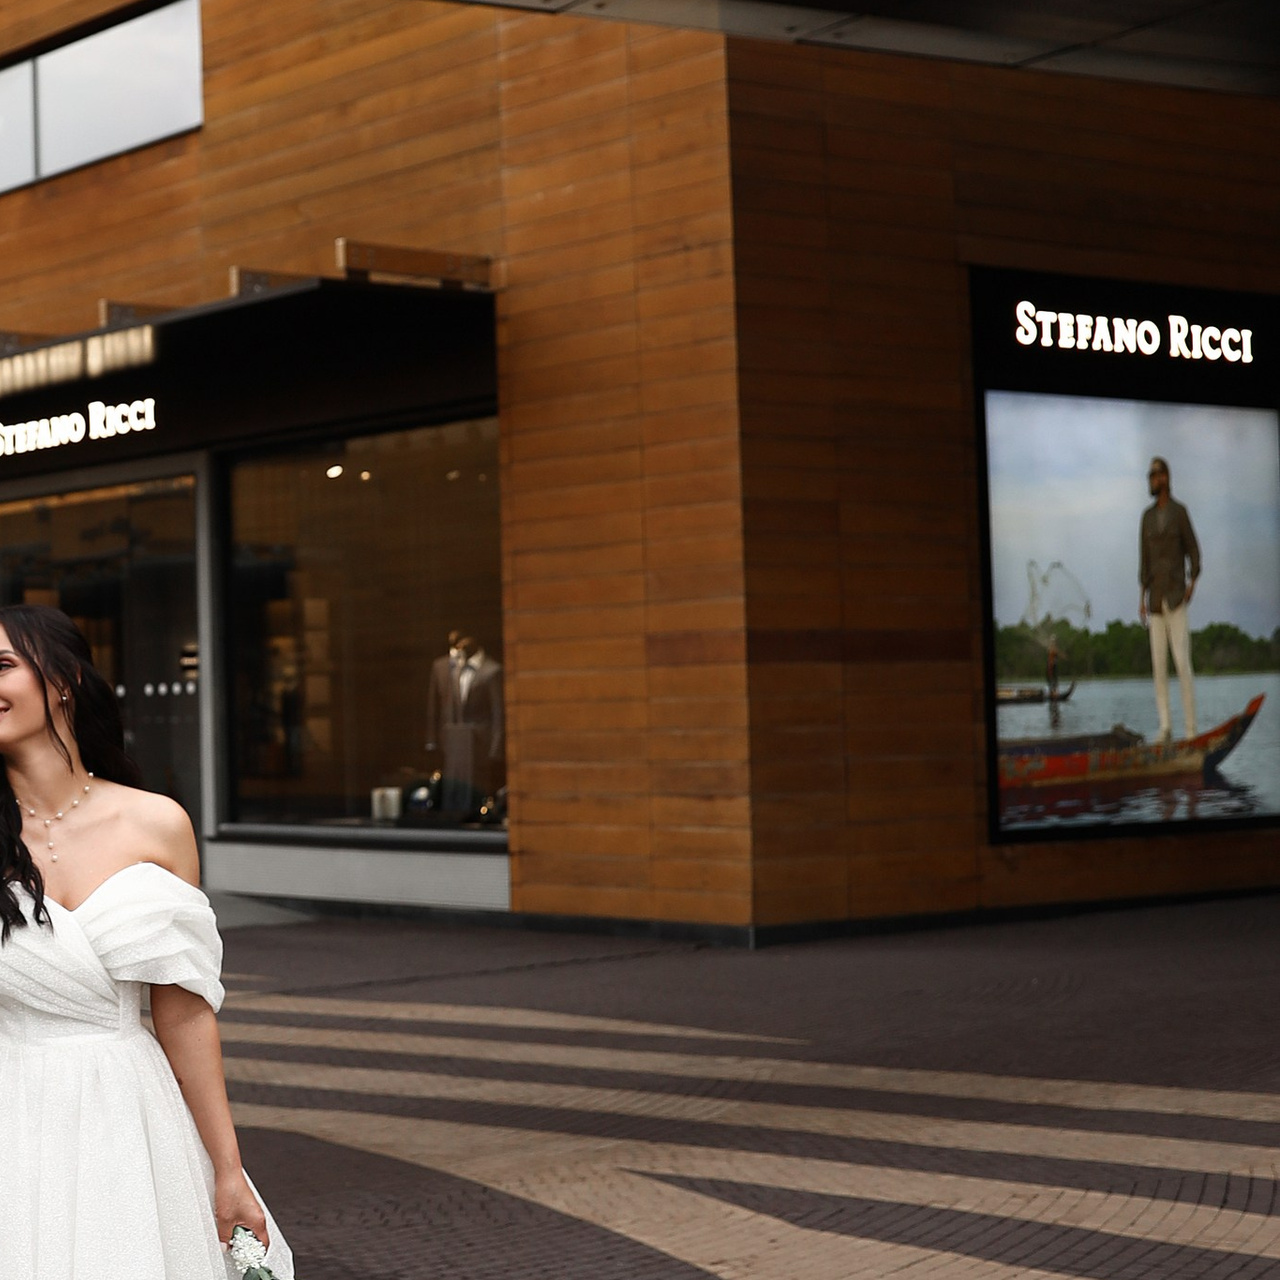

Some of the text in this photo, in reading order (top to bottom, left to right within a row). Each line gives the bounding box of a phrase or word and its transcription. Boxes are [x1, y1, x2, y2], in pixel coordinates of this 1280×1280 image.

[1015, 300, 1254, 364] STEFANO RICCI
[87, 397, 157, 440] RICCI
